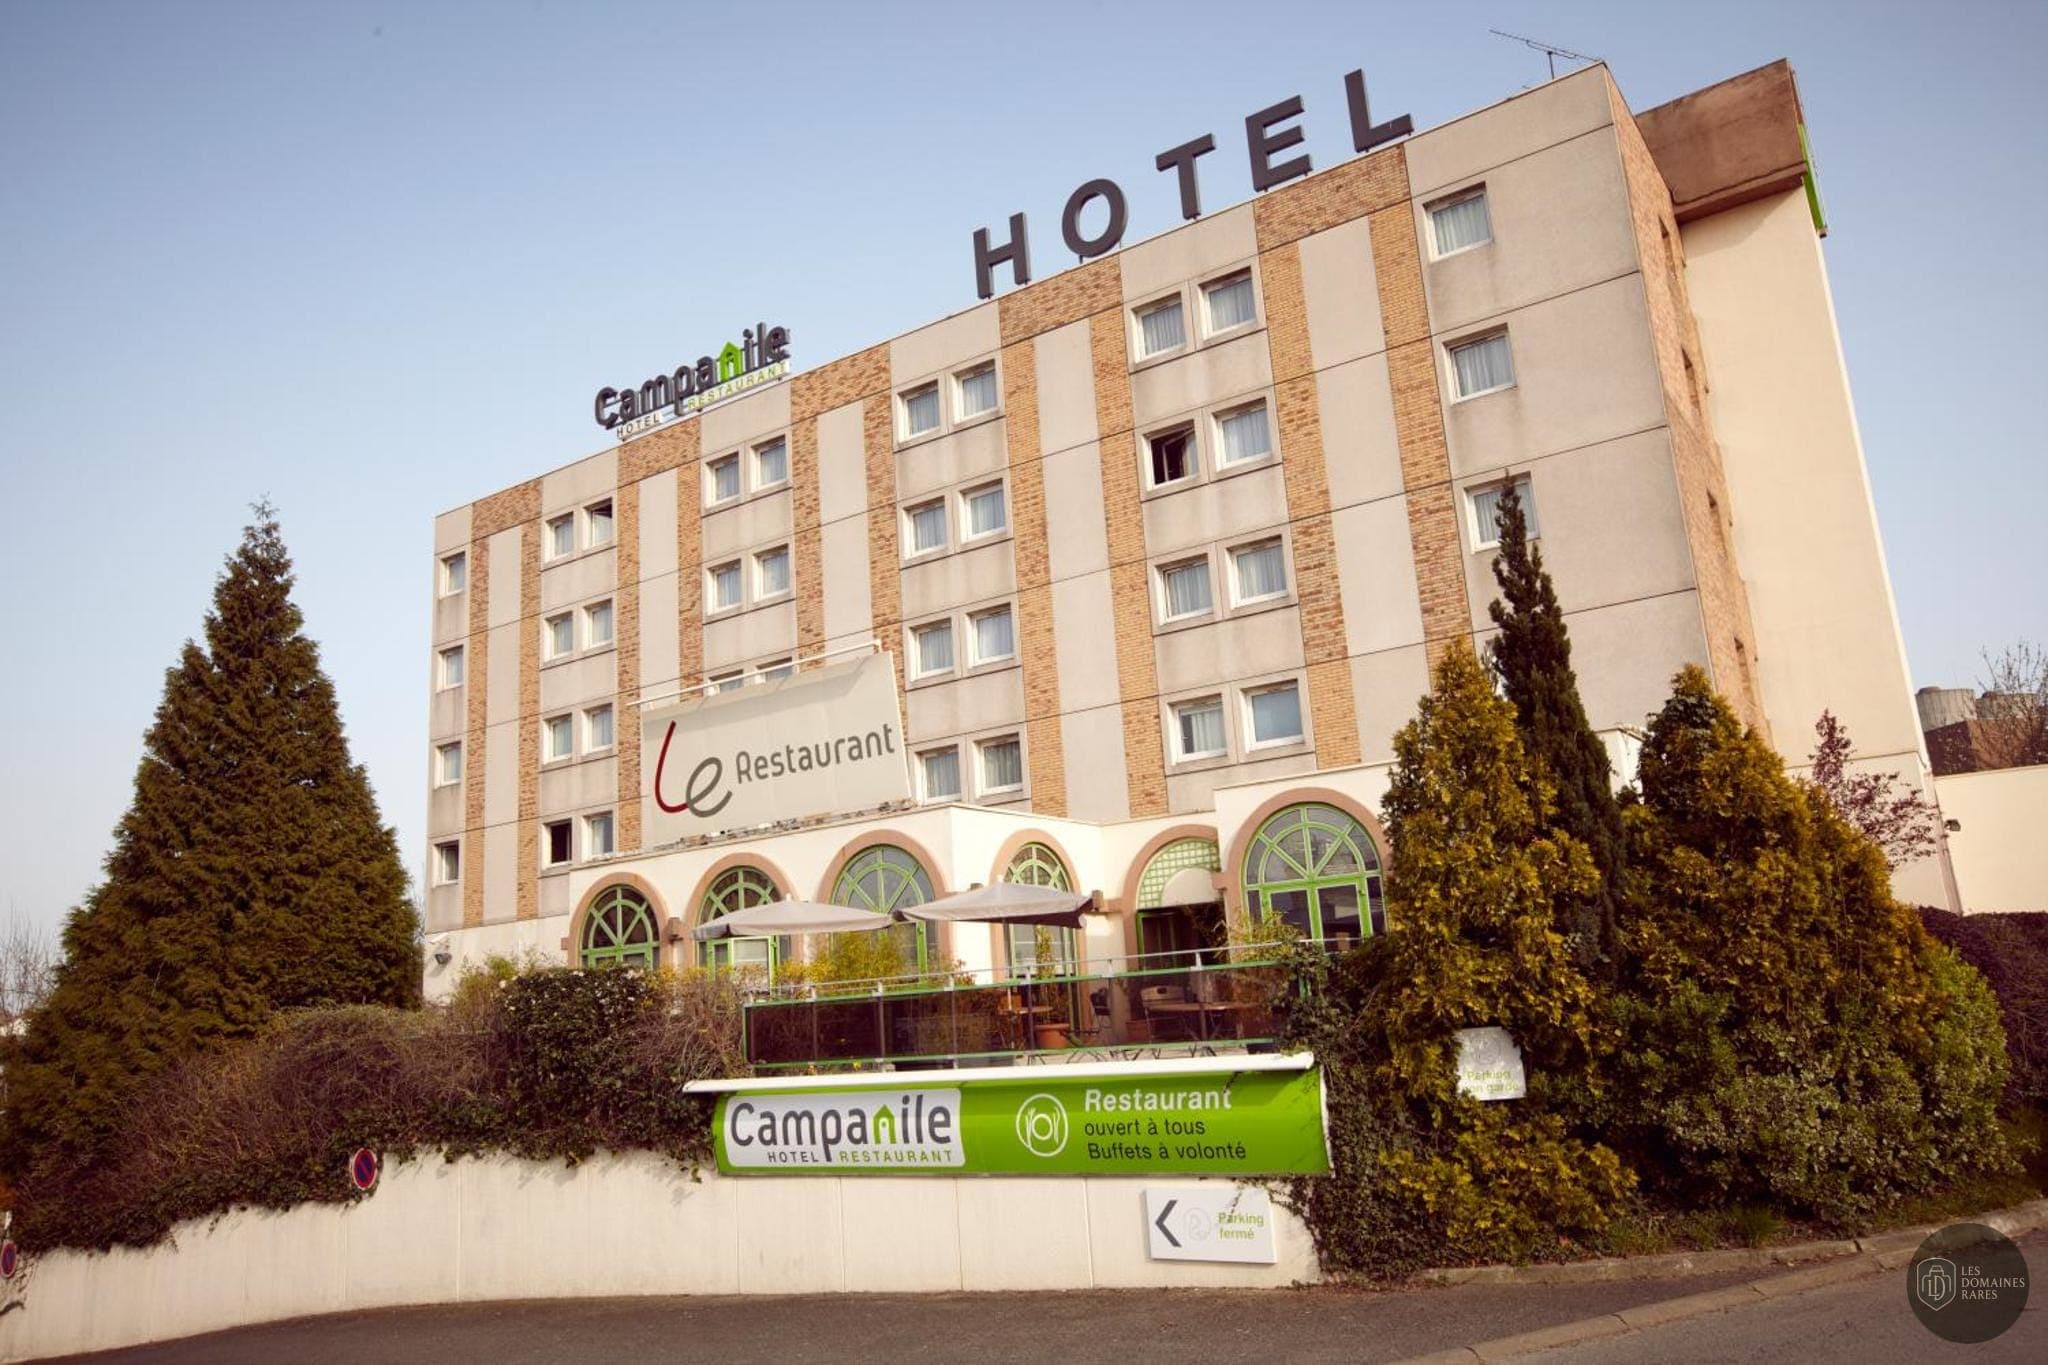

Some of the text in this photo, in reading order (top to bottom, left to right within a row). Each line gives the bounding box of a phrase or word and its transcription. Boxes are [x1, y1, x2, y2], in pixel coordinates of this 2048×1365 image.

[972, 68, 1415, 299] HOTEL
[594, 322, 791, 430] Campanile
[616, 363, 789, 438] HOTEL RESTAURANT
[655, 720, 896, 818] Le Restaurant
[1084, 1088, 1233, 1112] Restaurant
[730, 1094, 952, 1163] Campanile
[1084, 1117, 1206, 1136] ouvert à tous
[768, 1149, 952, 1163] HOTEL RESTAURANT
[1087, 1141, 1246, 1160] Buffets à volonté
[1217, 1211, 1265, 1228] Parking
[1219, 1227, 1256, 1240] fermé
